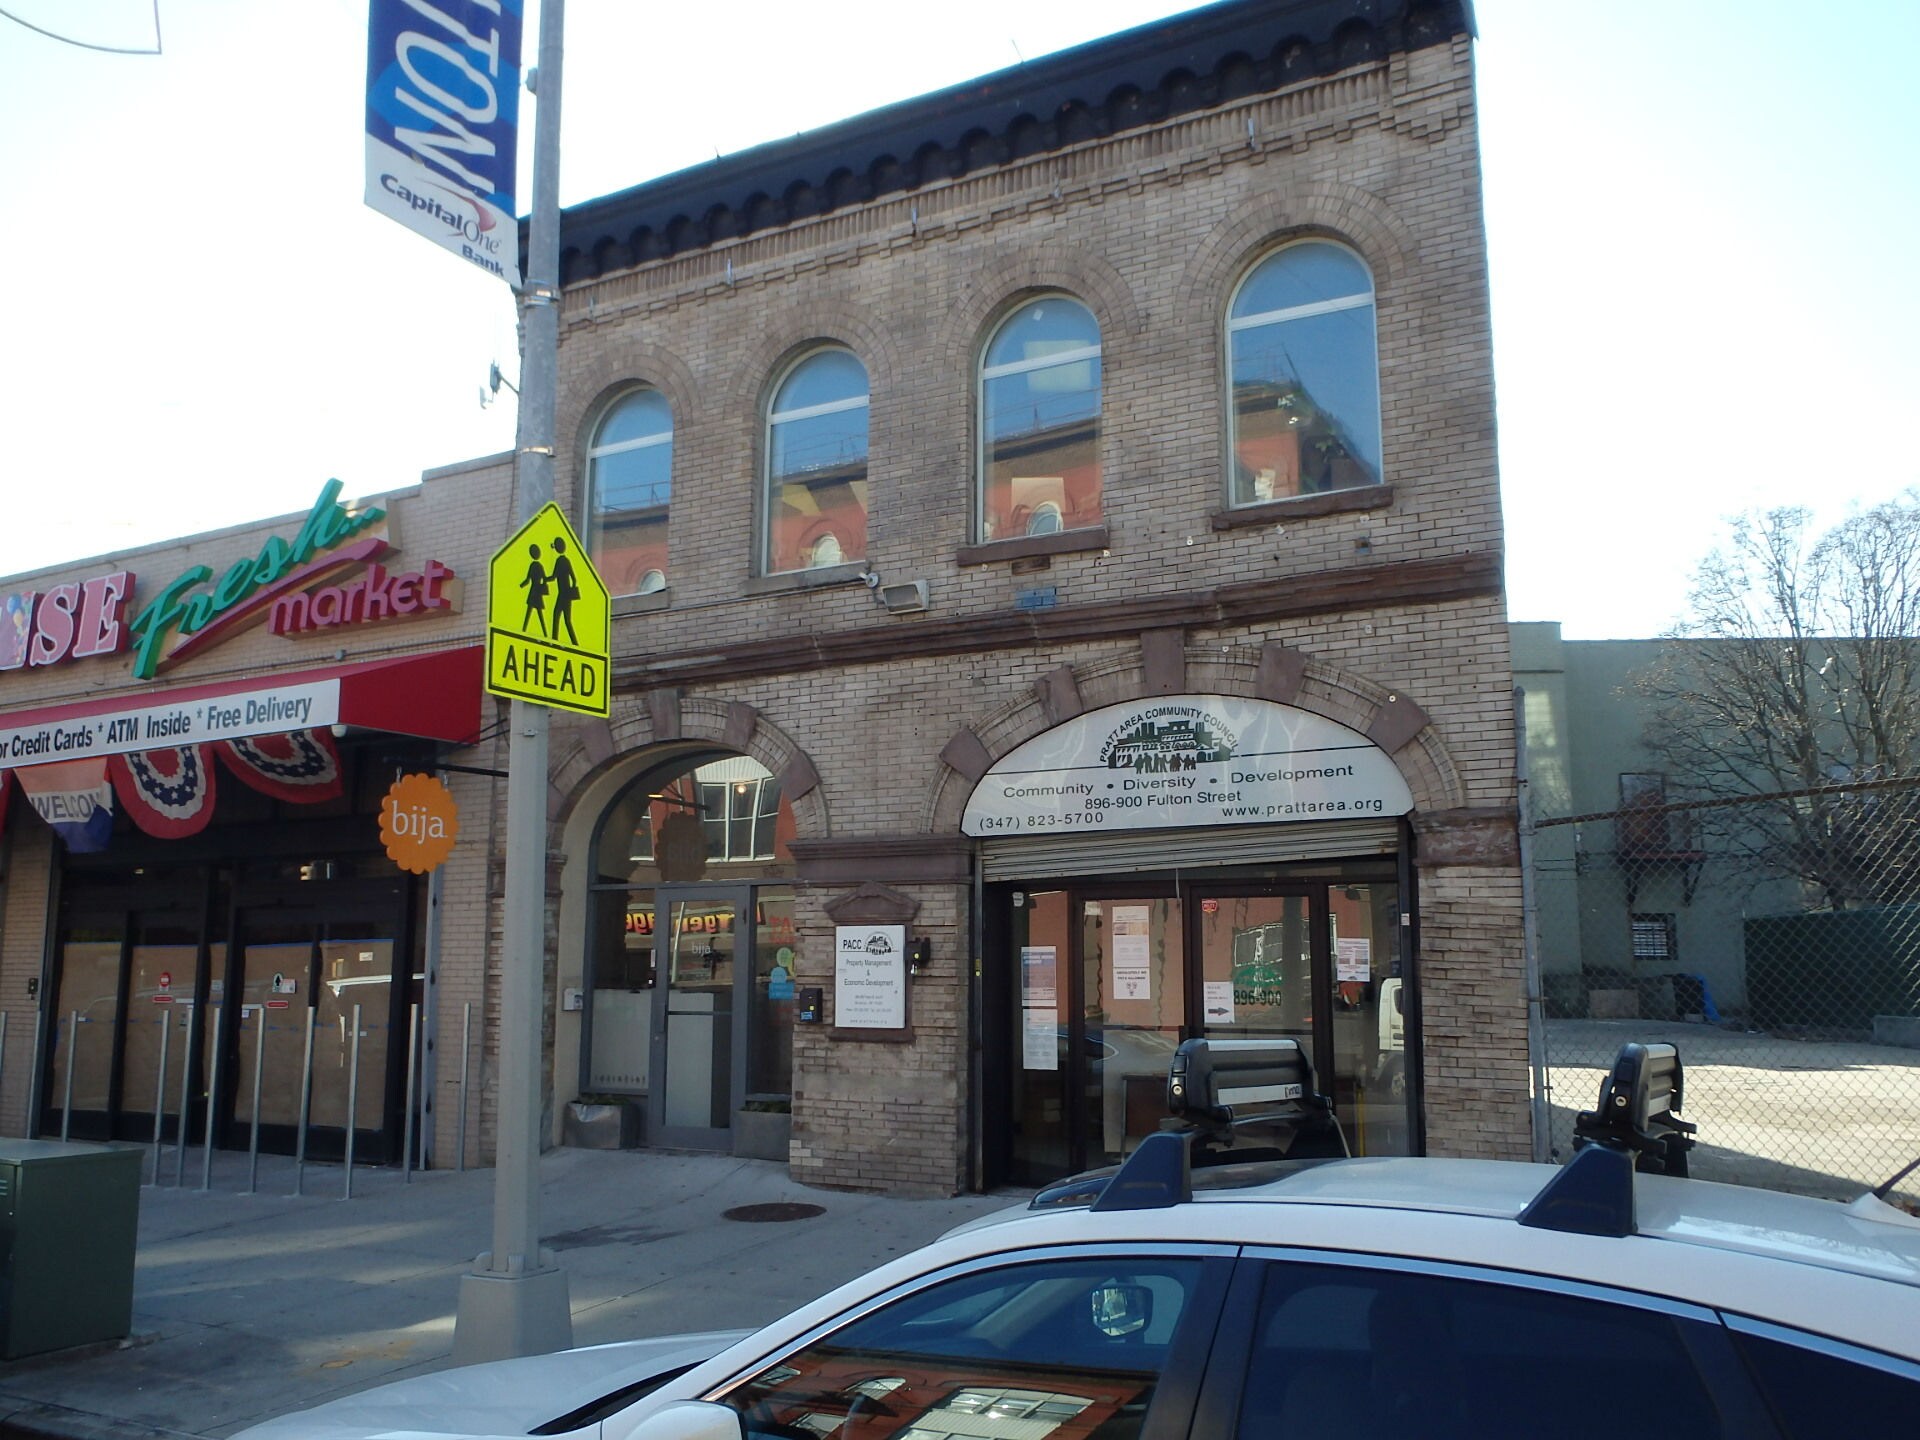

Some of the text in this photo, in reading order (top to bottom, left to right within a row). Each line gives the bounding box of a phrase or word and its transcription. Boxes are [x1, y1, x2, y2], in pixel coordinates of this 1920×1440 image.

[394, 0, 502, 195] TON
[462, 244, 505, 282] Bank
[268, 559, 450, 636] market
[501, 644, 596, 697] AHEAD
[11, 729, 51, 758] Credit
[54, 724, 93, 751] Cards
[106, 717, 139, 744] ATM
[146, 710, 191, 739] Inside
[207, 705, 242, 730] Free
[246, 696, 313, 724] Delivery
[1099, 706, 1239, 763] PRATT AREA COMMUNITY COUNCIL
[1003, 764, 1354, 799] Community Diversity Development
[1084, 790, 1242, 810] 896-900 Fulton Street
[1222, 798, 1383, 817] www.prattarea.org
[391, 800, 448, 845] bija
[979, 812, 1104, 832] (347) 823-5700
[842, 939, 862, 950] PACC
[864, 959, 892, 968] Management
[865, 978, 893, 987] Development
